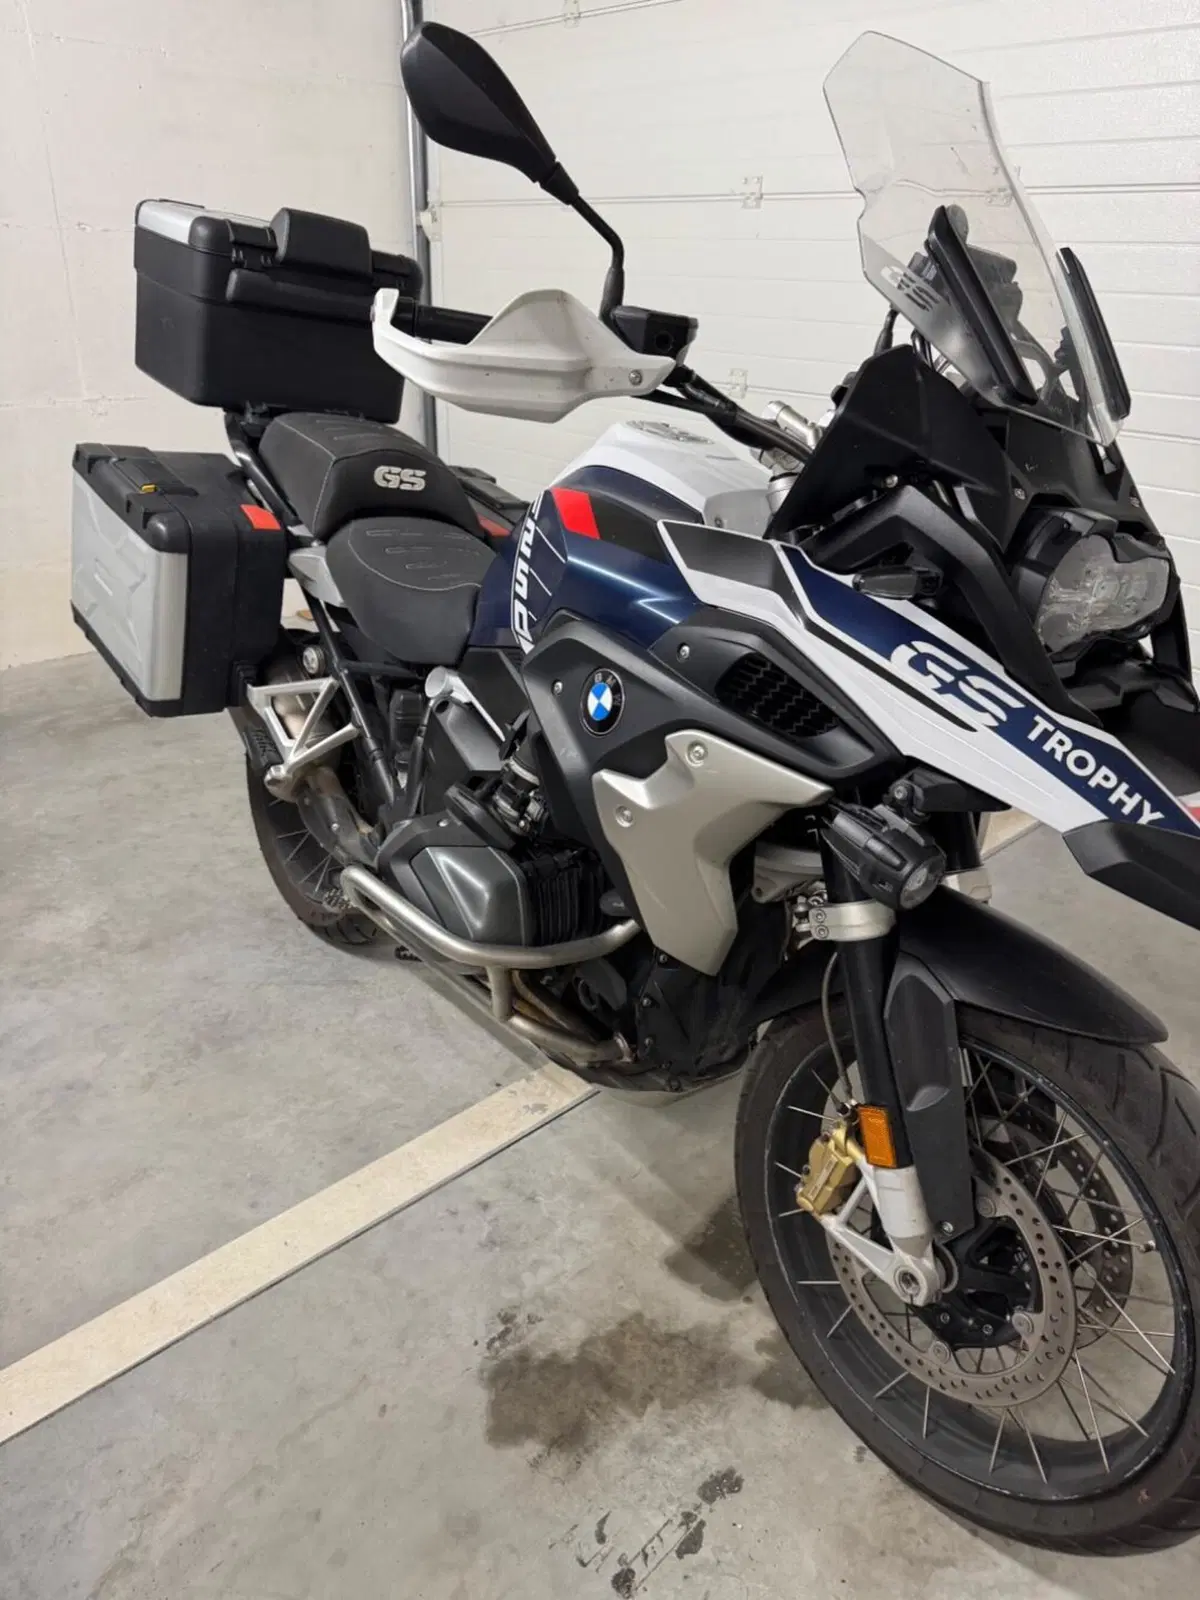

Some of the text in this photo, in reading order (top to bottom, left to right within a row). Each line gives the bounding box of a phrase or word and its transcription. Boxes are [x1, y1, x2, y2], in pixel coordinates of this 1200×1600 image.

[880, 265, 940, 312] GS
[373, 465, 427, 491] GS
[890, 640, 1164, 825] GS TROPHY
